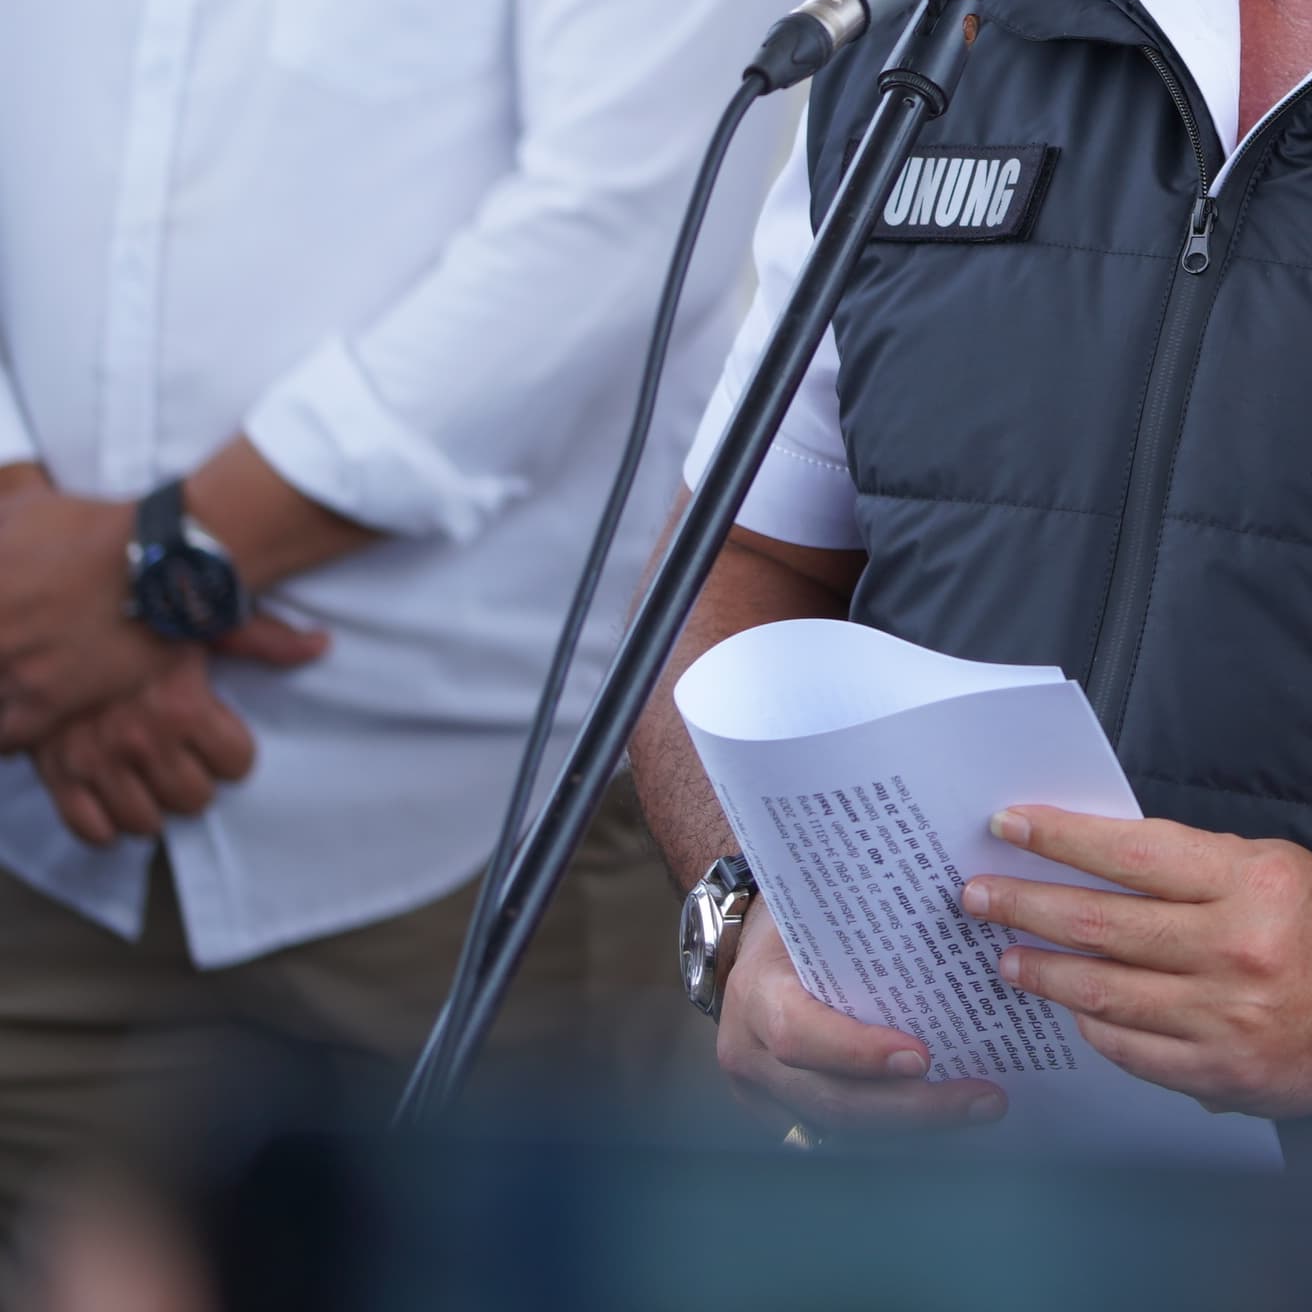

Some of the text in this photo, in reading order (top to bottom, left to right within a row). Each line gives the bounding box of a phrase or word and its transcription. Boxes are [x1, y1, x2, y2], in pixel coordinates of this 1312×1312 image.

[883, 157, 1022, 228] UNUNG
[871, 781, 890, 801] liter
[890, 774, 912, 802] Teknis
[795, 794, 817, 817] yang
[831, 789, 860, 823] sampai
[883, 802, 899, 816] 20
[906, 802, 930, 831] Syarat
[792, 822, 813, 848] tahun
[854, 828, 872, 841] ml
[875, 824, 901, 855] standar
[894, 819, 913, 834] per
[785, 841, 805, 863] yang
[866, 847, 884, 865] 400
[903, 836, 920, 850] ml
[924, 830, 950, 863] tentang
[807, 851, 839, 887] produksi
[831, 860, 854, 883] SPBU
[913, 852, 932, 870] 100
[799, 865, 829, 908] tambahan
[847, 884, 860, 893] di
[943, 864, 966, 888] 2020
[832, 890, 857, 925] Tatsuno
[892, 885, 916, 915] antara
[935, 884, 963, 919] sebesar
[822, 910, 840, 927] alat
[855, 894, 883, 934] Pertamax
[812, 792, 989, 1075] diukur menggunakan Bejana Ukur Standar 20 liter diperoleh hasil
[935, 916, 953, 940] liter,
[955, 921, 979, 948] SPBU
[834, 929, 855, 955] fungsi
[853, 928, 875, 955] merek
[878, 934, 895, 951] dan
[911, 920, 946, 966] bervariasi
[946, 942, 962, 956] 20
[850, 957, 877, 994] terhadap
[868, 958, 889, 977] BBM
[958, 960, 977, 976] per
[974, 950, 997, 975] pada
[967, 979, 984, 993] ml
[987, 977, 1008, 1000] BBM
[887, 985, 912, 1014] pompa
[944, 971, 987, 1032] pengurangan
[978, 997, 996, 1016] 600
[927, 1015, 942, 1030] Bio
[1024, 1008, 1046, 1040] Dirjen
[1048, 1020, 1065, 1041] arus
[935, 1029, 957, 1050] jenis
[1003, 1003, 1045, 1070] pengurangan
[979, 1038, 1007, 1073] deviasi
[999, 1034, 1024, 1071] dengan
[1059, 1043, 1078, 1070] Meter
